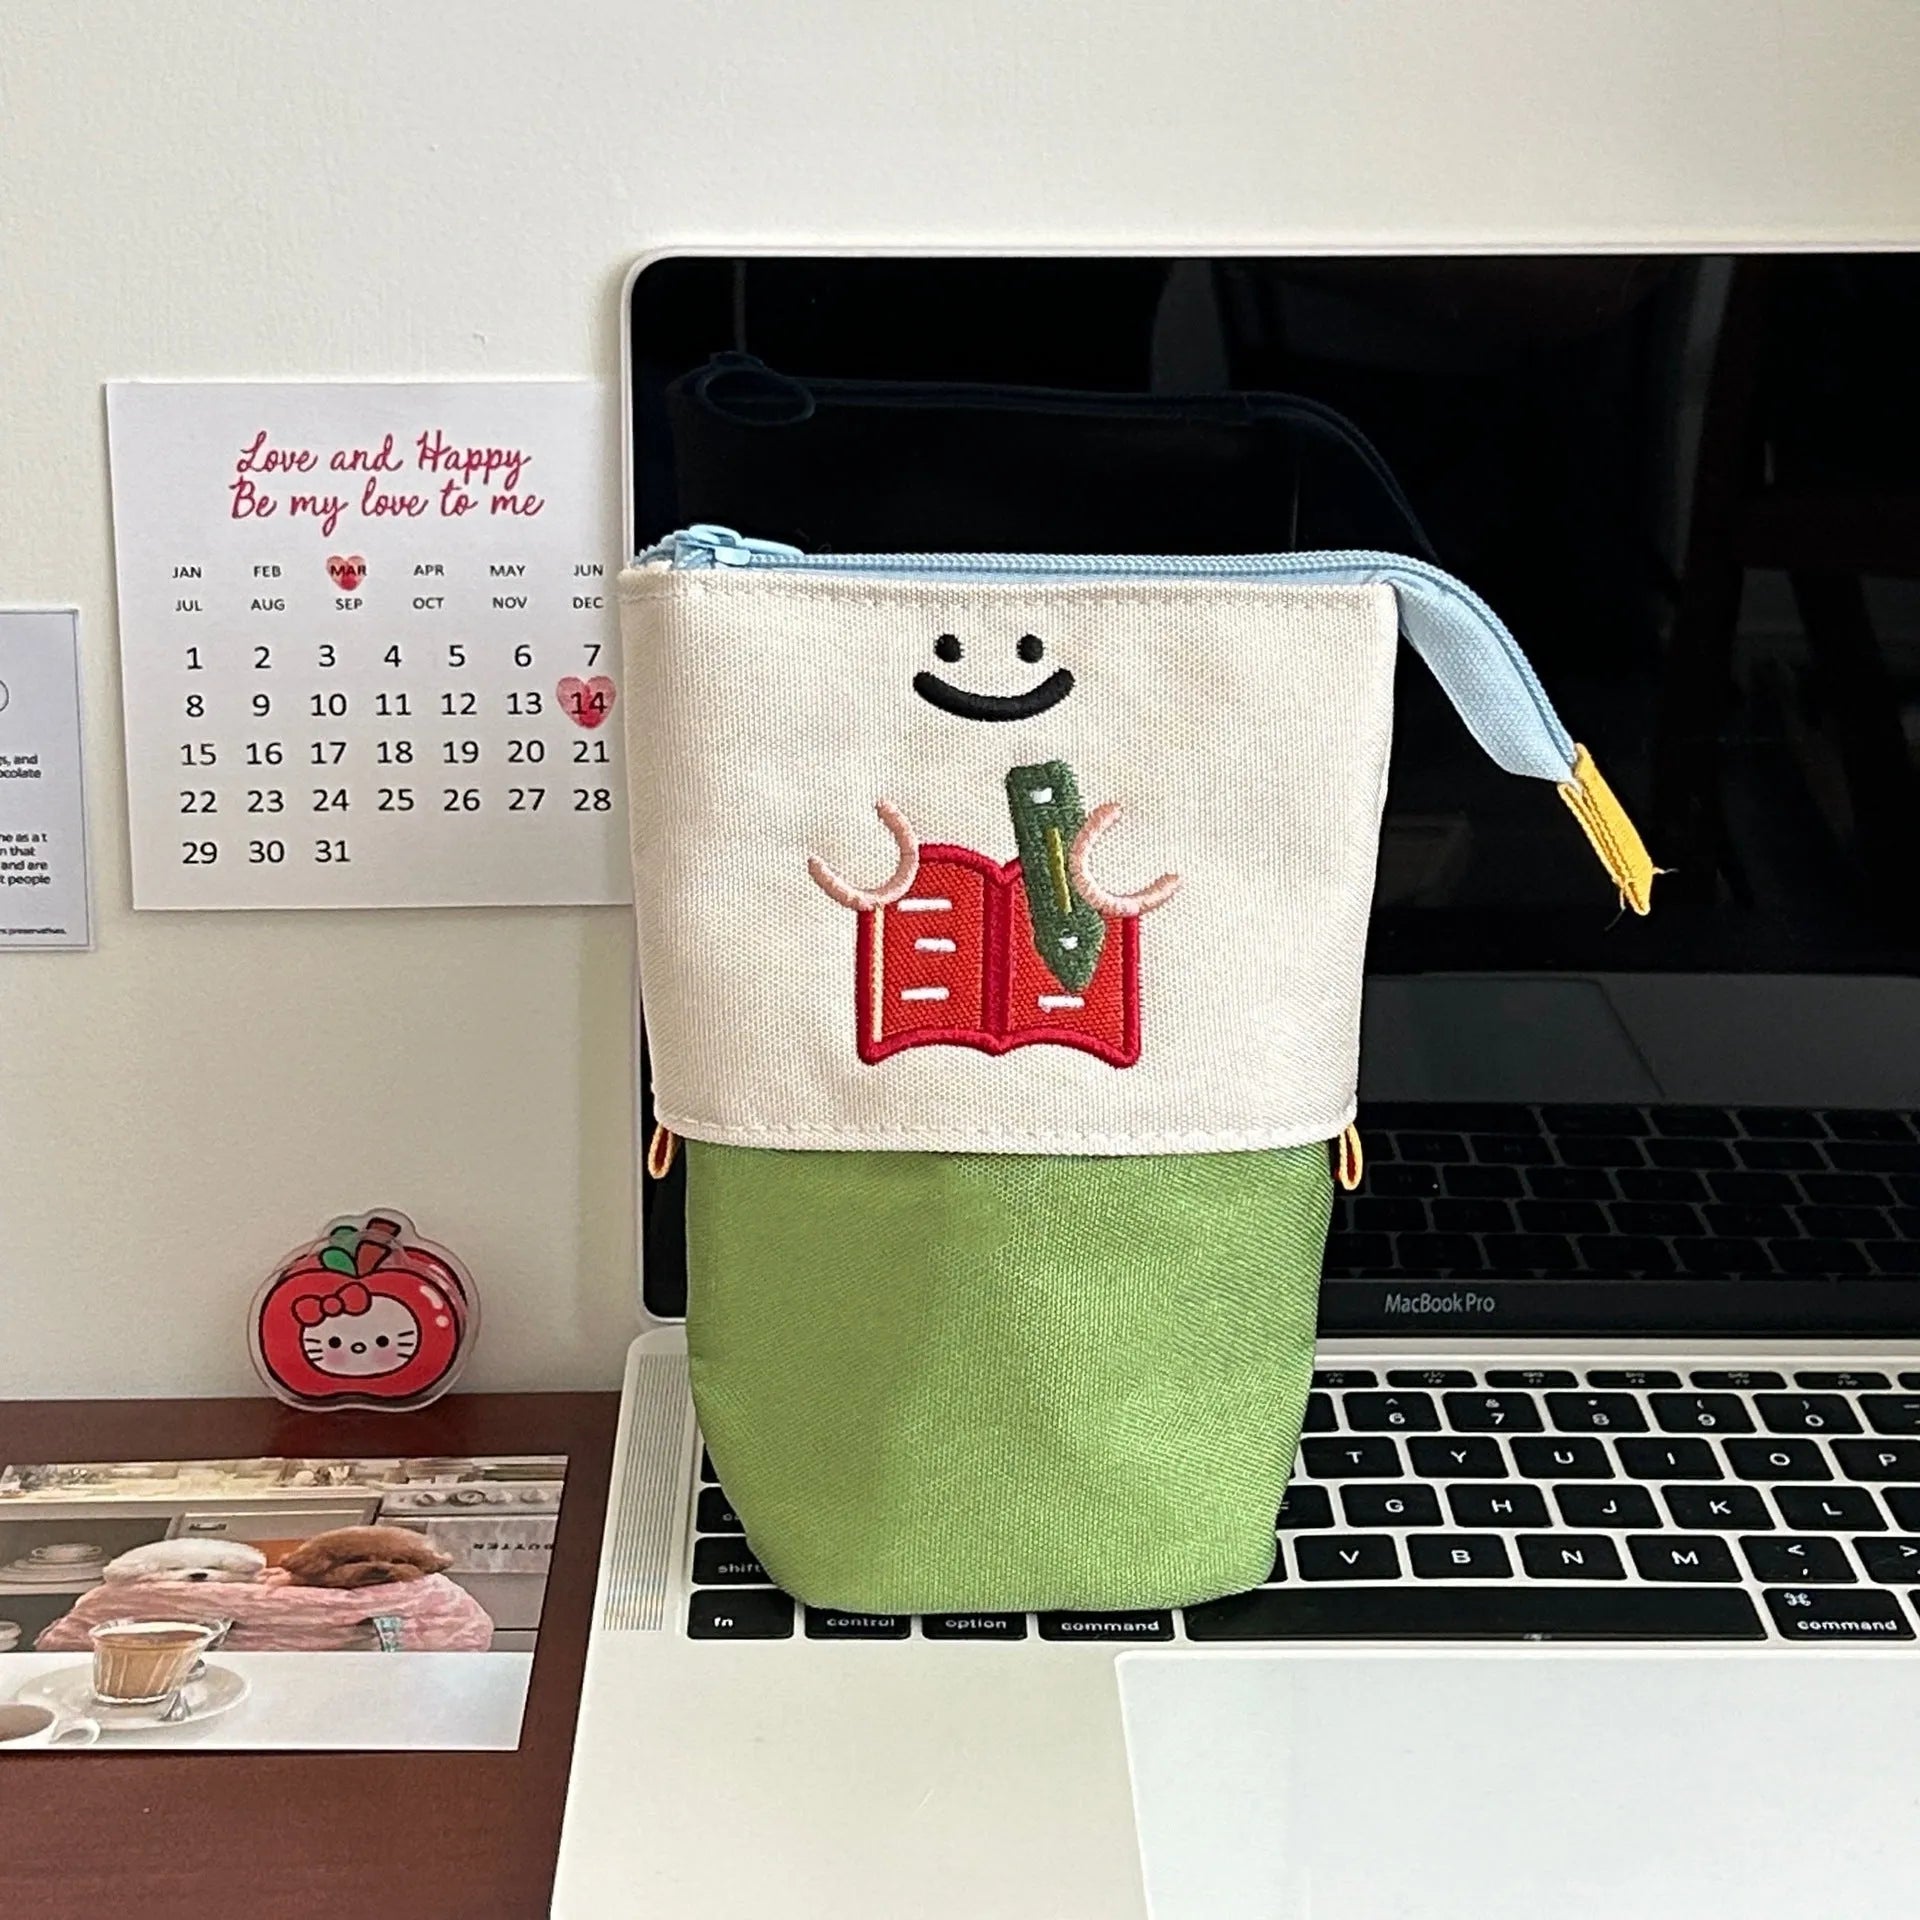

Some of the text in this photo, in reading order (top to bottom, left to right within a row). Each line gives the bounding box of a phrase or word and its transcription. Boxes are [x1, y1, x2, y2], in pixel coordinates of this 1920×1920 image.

[237, 430, 531, 489] Love and Happy
[230, 476, 544, 537] Be my love to me
[173, 565, 603, 578] JAN FEB MAR APR MAY JUN
[176, 597, 603, 611] JUL AUG SEP OCT NOV DEC
[187, 645, 600, 669] 1 2 3 4 5 6 7
[186, 691, 607, 717] 8 9 10 11 12 13 14
[181, 740, 609, 765] 15 16 17 18 19 20 21
[14, 755, 38, 765] and
[181, 789, 611, 813] 22 23 24 25 26 27 28
[10, 846, 35, 856] that
[183, 840, 350, 864] 29 30 31
[1, 861, 48, 870] and are
[8, 875, 51, 886] people
[1386, 1293, 1494, 1312] MacBook Pro
[1345, 1451, 1363, 1464] T
[1450, 1451, 1467, 1464] Y
[1553, 1451, 1574, 1464] U
[1667, 1452, 1675, 1465] I
[1769, 1452, 1791, 1466] O
[1878, 1453, 1897, 1466] P
[1385, 1499, 1404, 1513] G
[1491, 1499, 1513, 1513] H
[1602, 1500, 1617, 1514] J
[1709, 1500, 1731, 1514] K
[1822, 1502, 1842, 1515] L
[1339, 1550, 1360, 1564] V
[1451, 1549, 1471, 1564] B
[1561, 1550, 1584, 1564] N
[1671, 1550, 1699, 1565] M
[718, 1563, 761, 1574] shift
[714, 1617, 733, 1627] fn
[826, 1618, 895, 1627] control
[945, 1619, 1007, 1629] option
[1061, 1620, 1159, 1631] command
[1797, 1619, 1897, 1631] command
